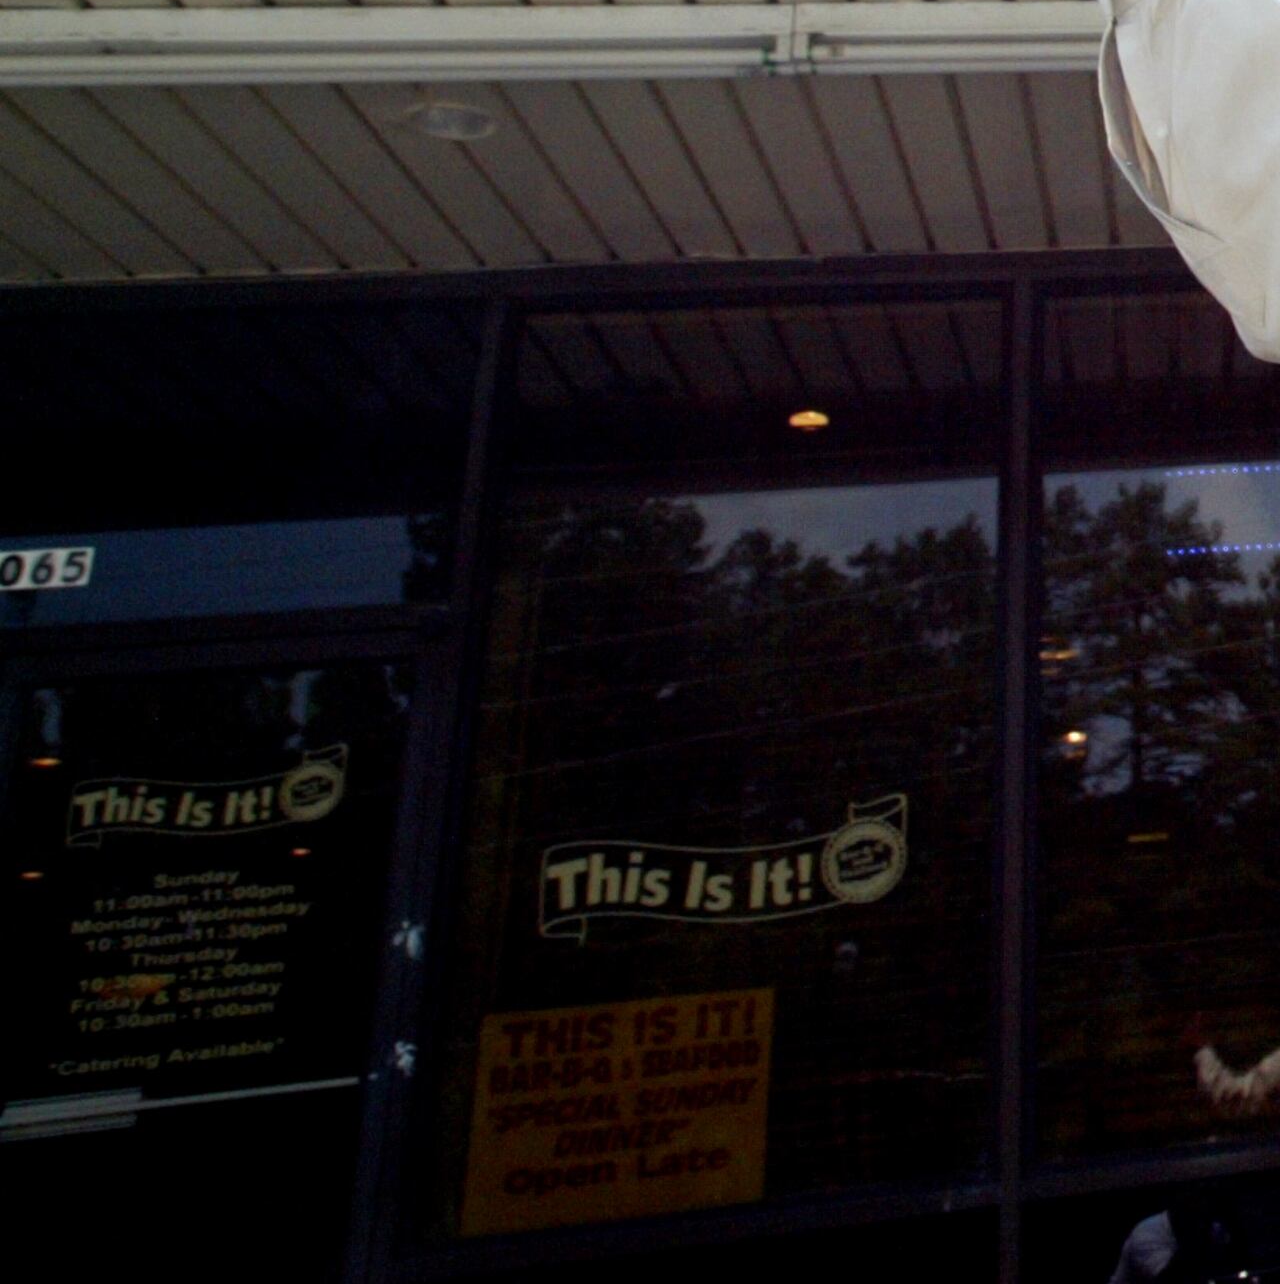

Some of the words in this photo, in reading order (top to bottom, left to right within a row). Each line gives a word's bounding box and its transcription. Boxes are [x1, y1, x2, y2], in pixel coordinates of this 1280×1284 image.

[0, 551, 87, 587] 065
[72, 786, 166, 828] This
[174, 790, 215, 828] Is
[223, 785, 275, 826] It!
[152, 870, 240, 889] Sunday
[545, 850, 673, 910] This
[683, 860, 735, 911] Is
[749, 852, 815, 910] It!
[130, 947, 239, 968] Thursday
[70, 995, 146, 1015] Friday
[152, 989, 170, 1006] &
[177, 981, 284, 1003] Saturday
[501, 1012, 616, 1058] THIS
[634, 1006, 678, 1045] IS
[696, 997, 756, 1038] IT!
[634, 1078, 759, 1117] SUNDAY
[504, 1160, 617, 1196] Open
[637, 1146, 730, 1181] Late
